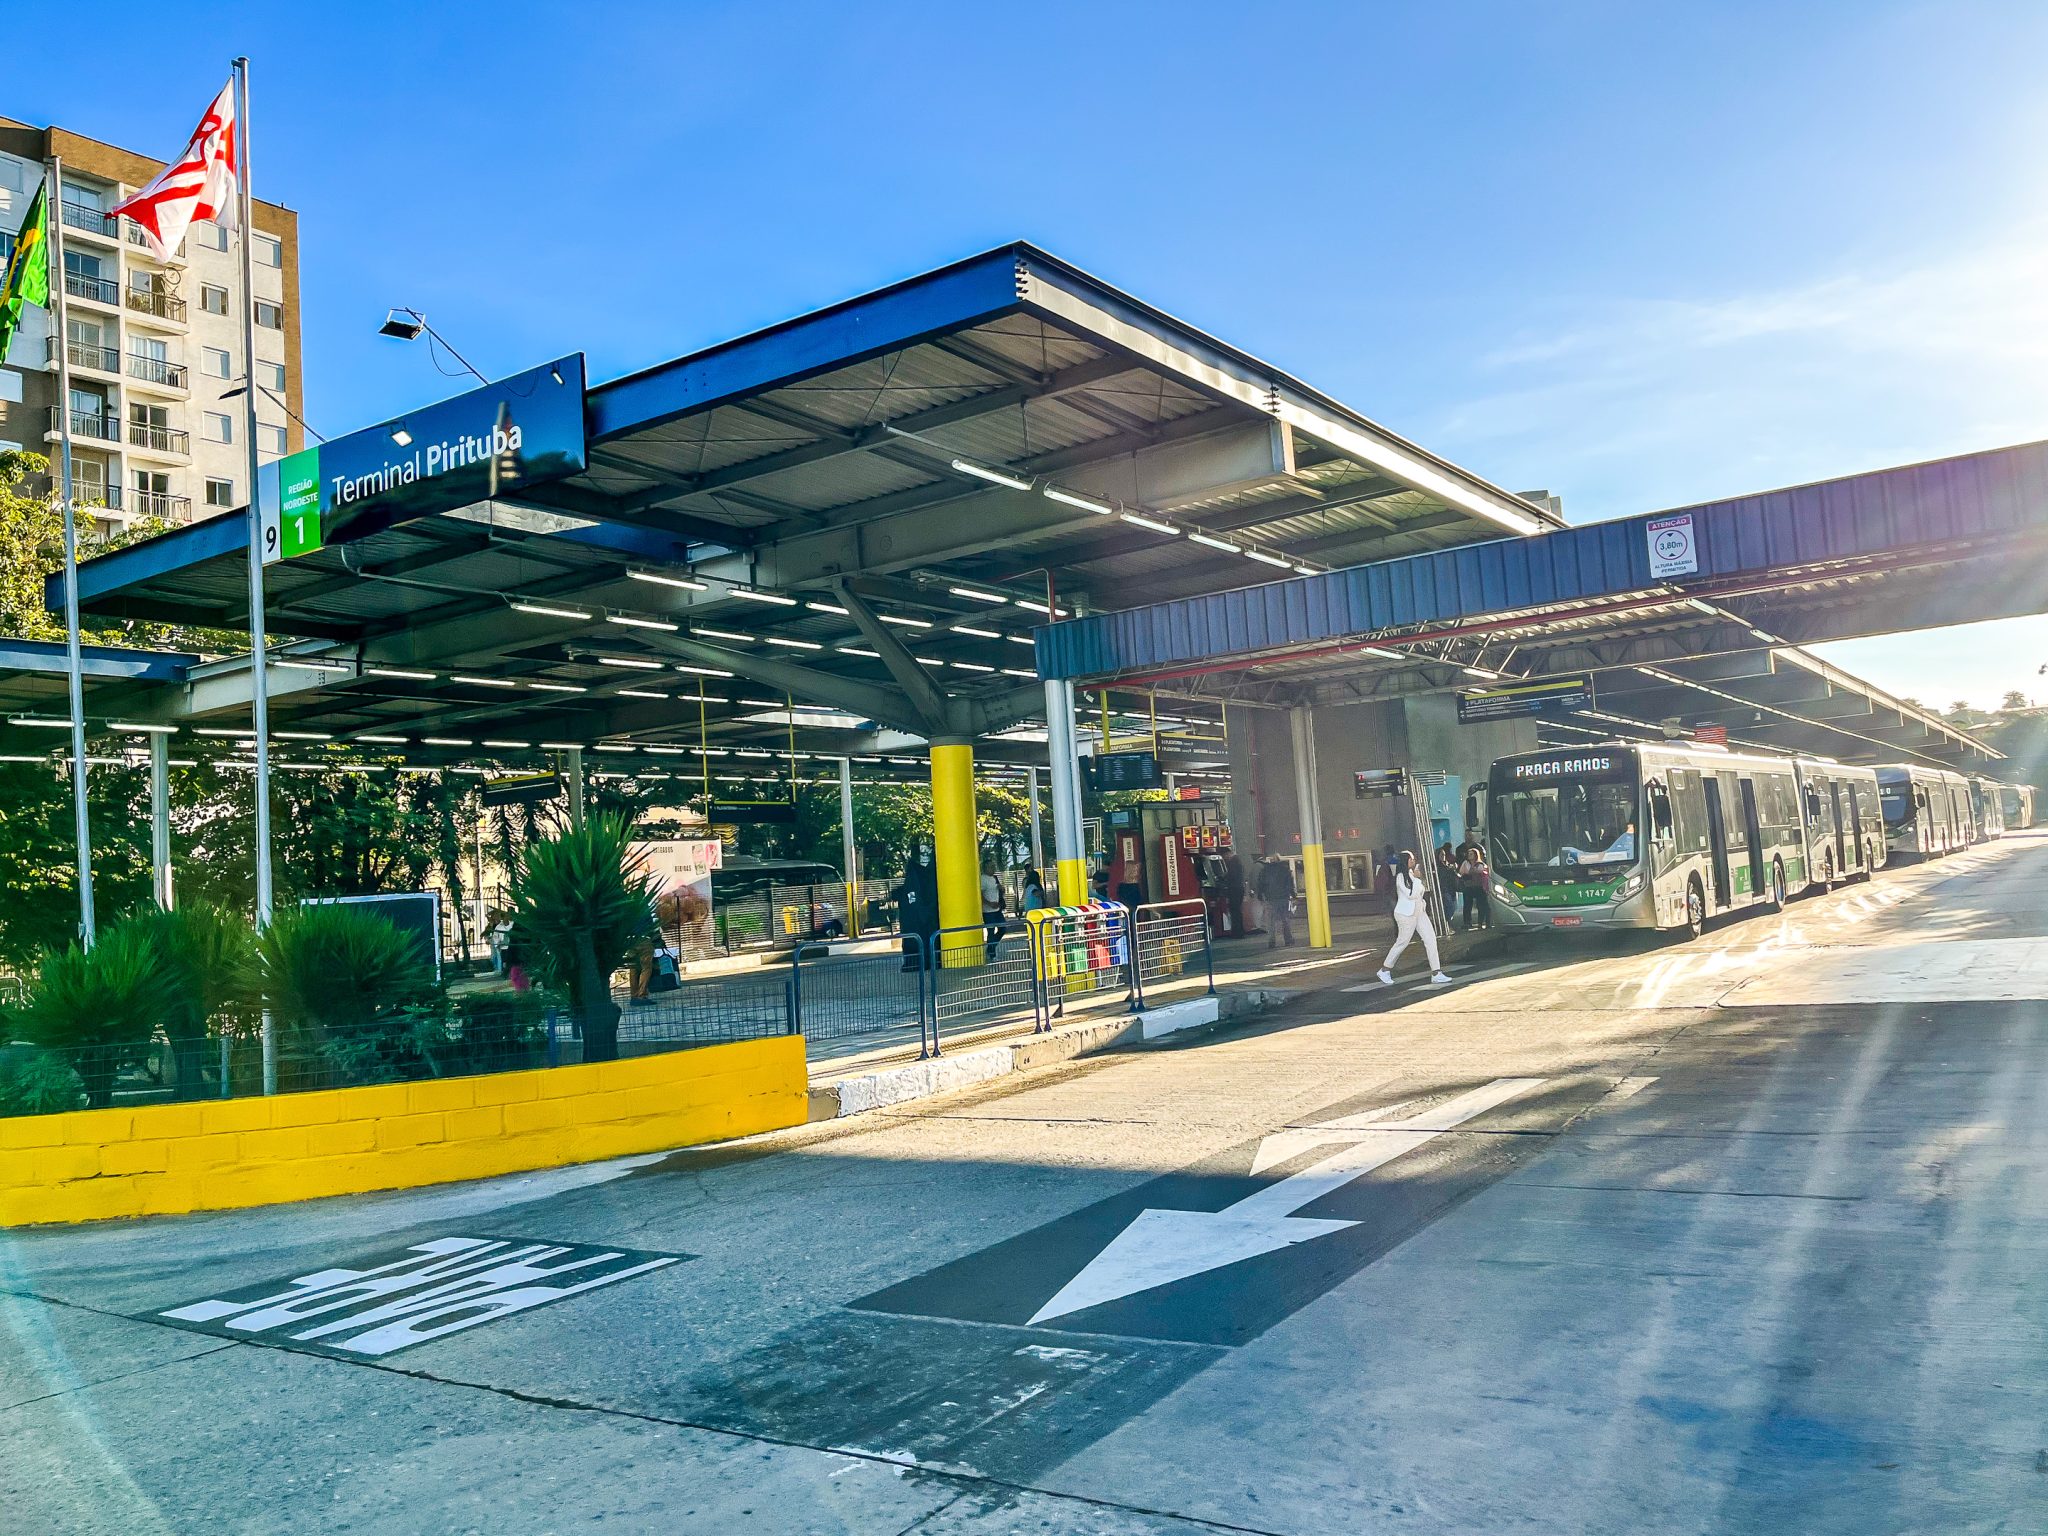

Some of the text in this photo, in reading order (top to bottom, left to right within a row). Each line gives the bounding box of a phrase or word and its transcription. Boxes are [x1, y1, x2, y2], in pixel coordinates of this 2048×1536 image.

[332, 424, 522, 505] Terminal Pirituba
[288, 479, 313, 495] REGIÃO
[283, 492, 319, 511] NOROESTE
[265, 526, 277, 553] 9
[294, 517, 305, 544] 1
[1470, 696, 1511, 706] PLATAFORMA
[1564, 758, 1610, 773] RAMOS
[1169, 840, 1177, 891] Banco24Horas
[1585, 889, 1606, 898] 1747
